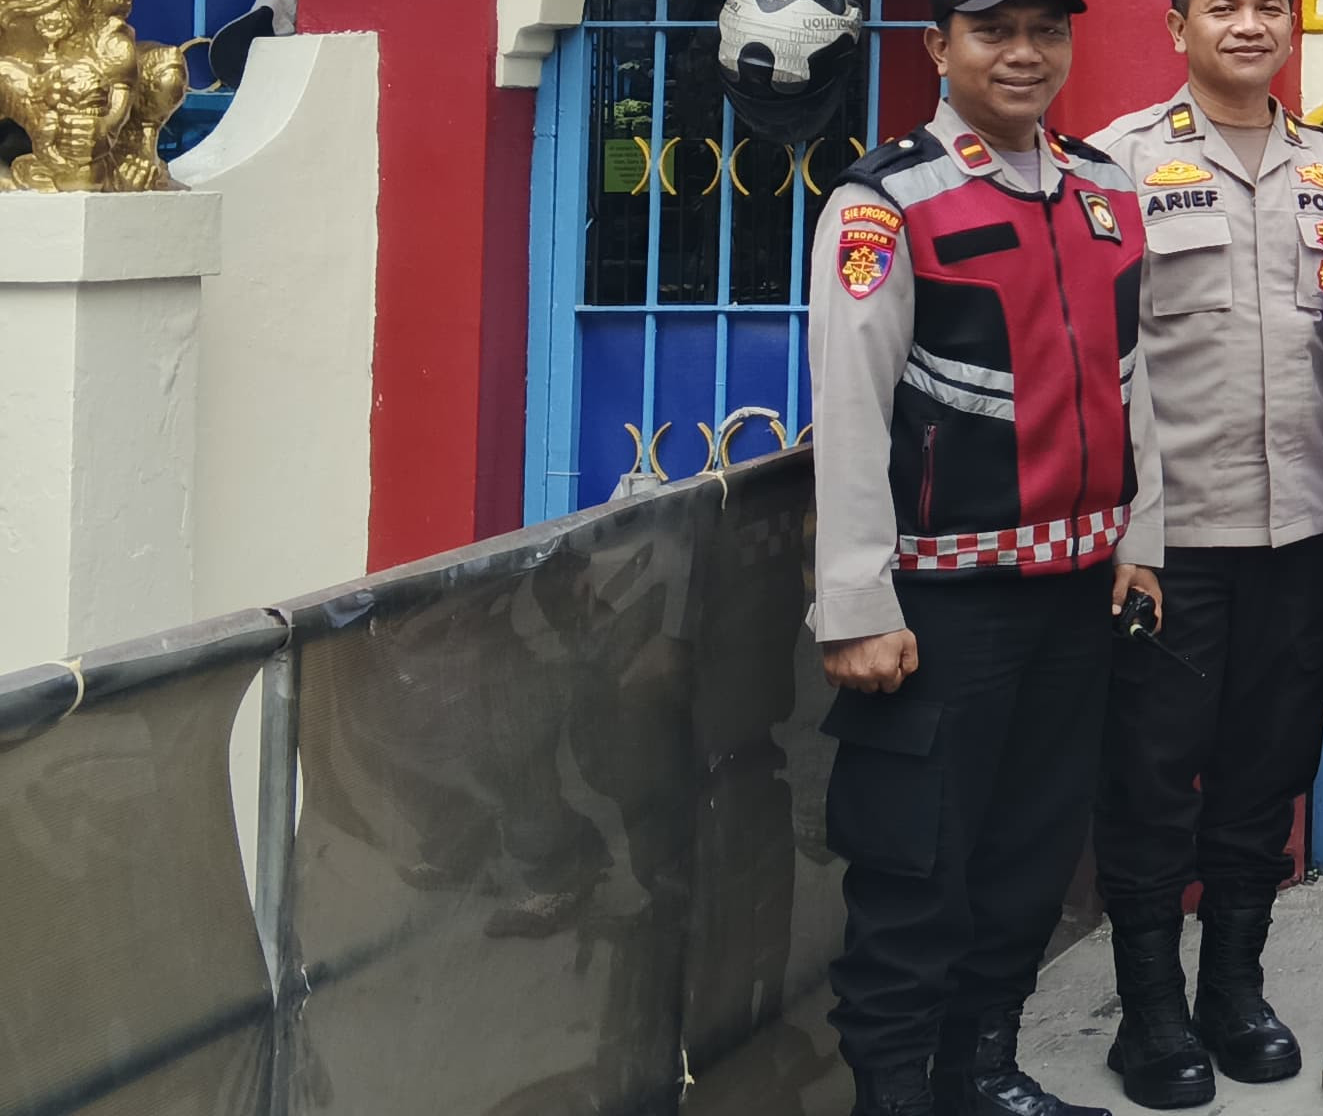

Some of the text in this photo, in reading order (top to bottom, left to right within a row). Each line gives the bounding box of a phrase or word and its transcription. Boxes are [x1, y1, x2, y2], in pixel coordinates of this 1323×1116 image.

[1147, 190, 1218, 216] ARIEF
[844, 206, 899, 228] SIE PROPAM
[847, 231, 888, 245] PROPAM
